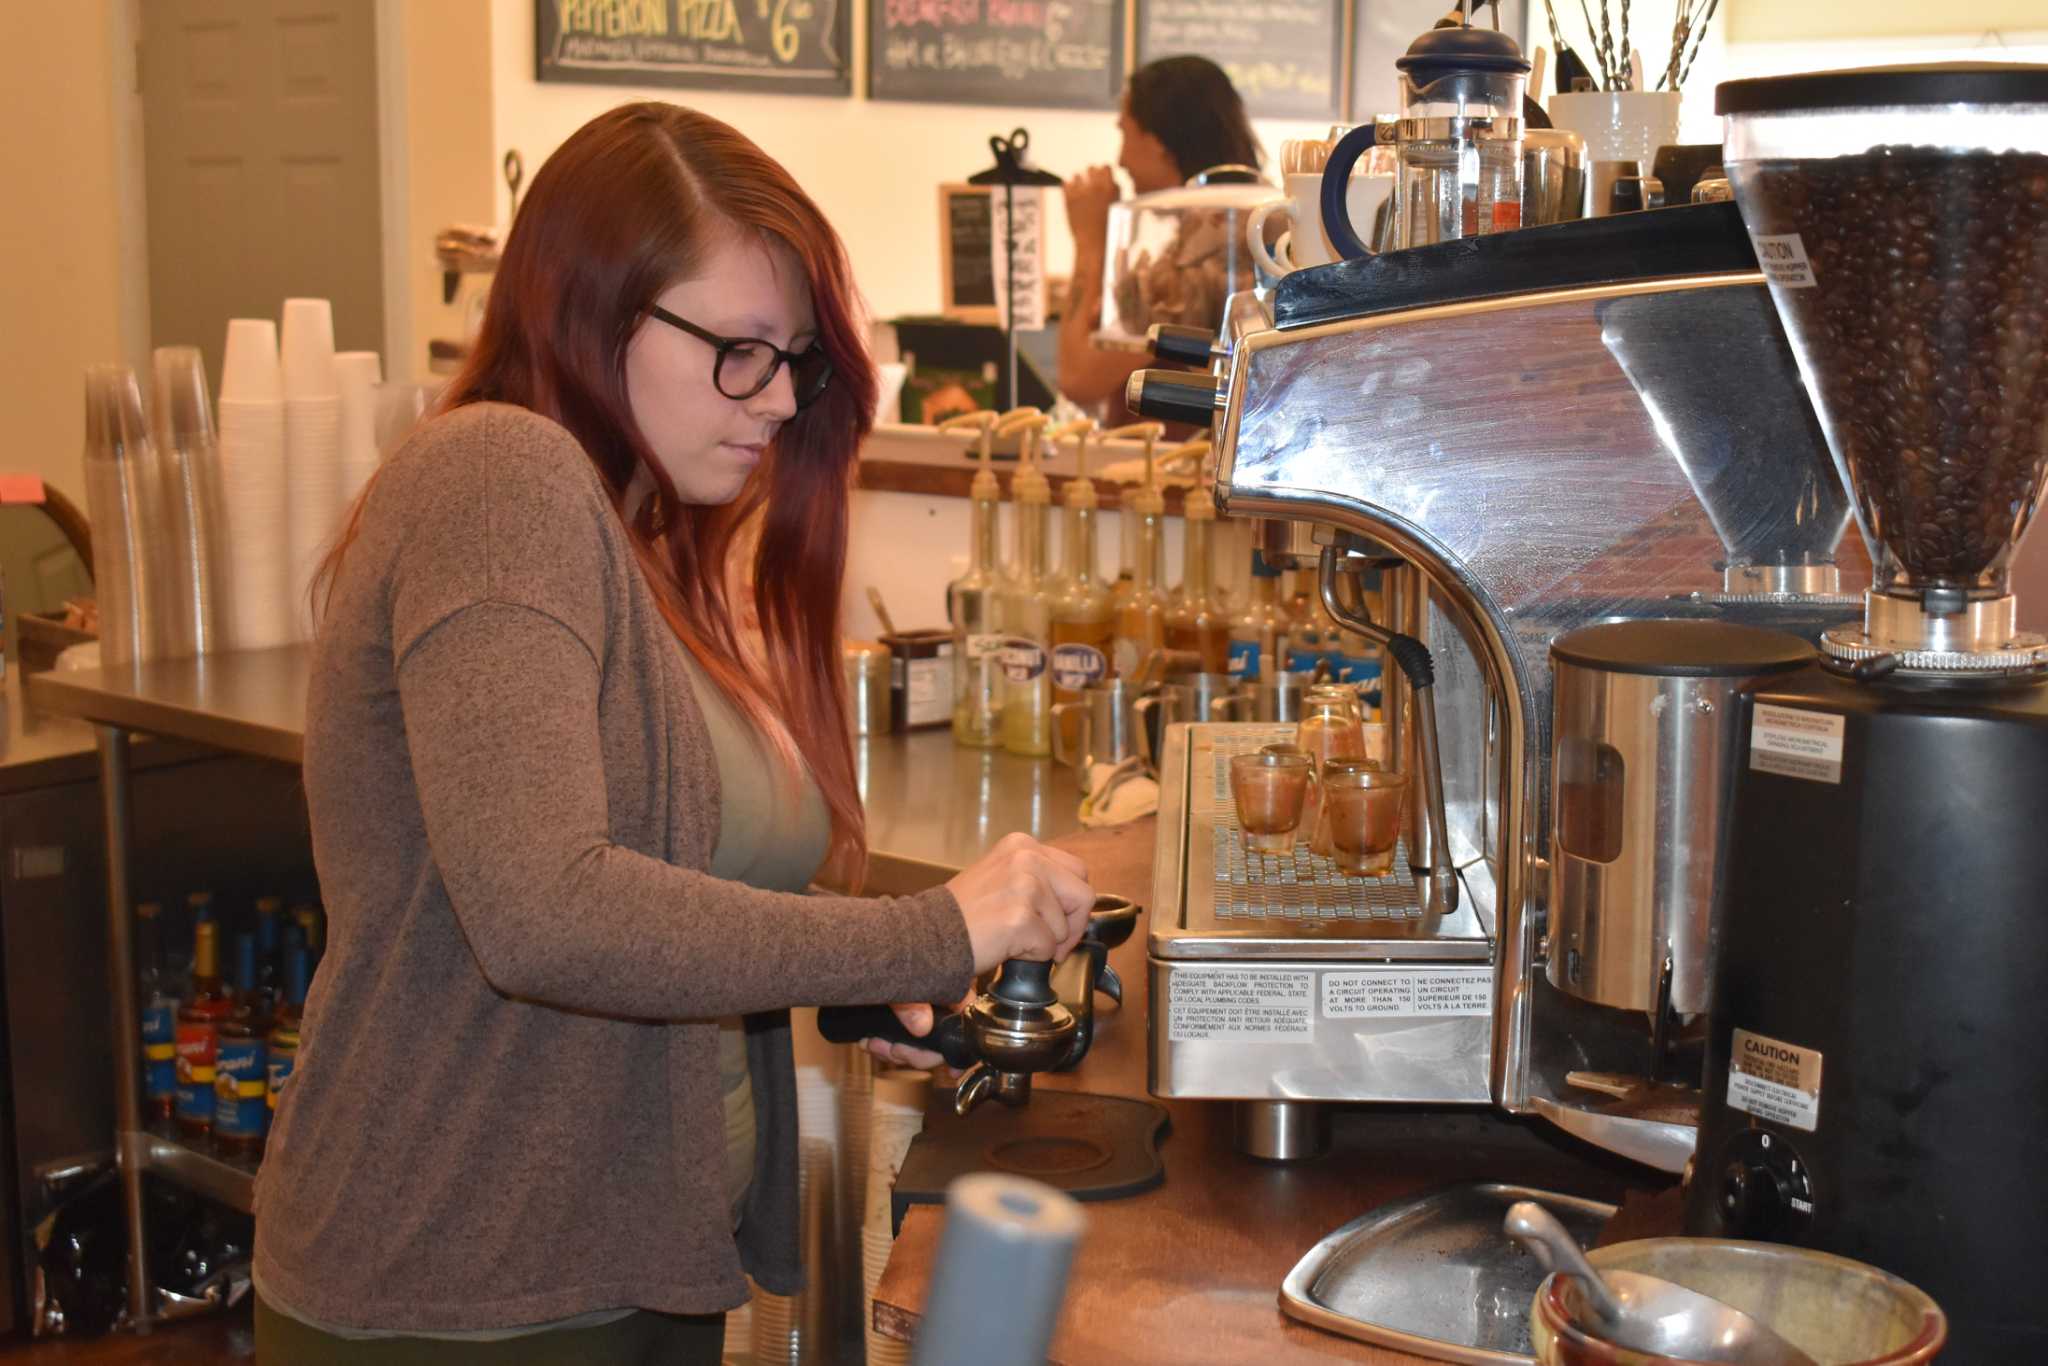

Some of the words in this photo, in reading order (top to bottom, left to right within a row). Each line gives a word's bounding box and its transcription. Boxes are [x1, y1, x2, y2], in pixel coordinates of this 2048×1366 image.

[678, 0, 744, 44] PIZZA
[1429, 977, 1476, 985] CONNECTEZ
[1744, 1038, 1800, 1066] CAUTION
